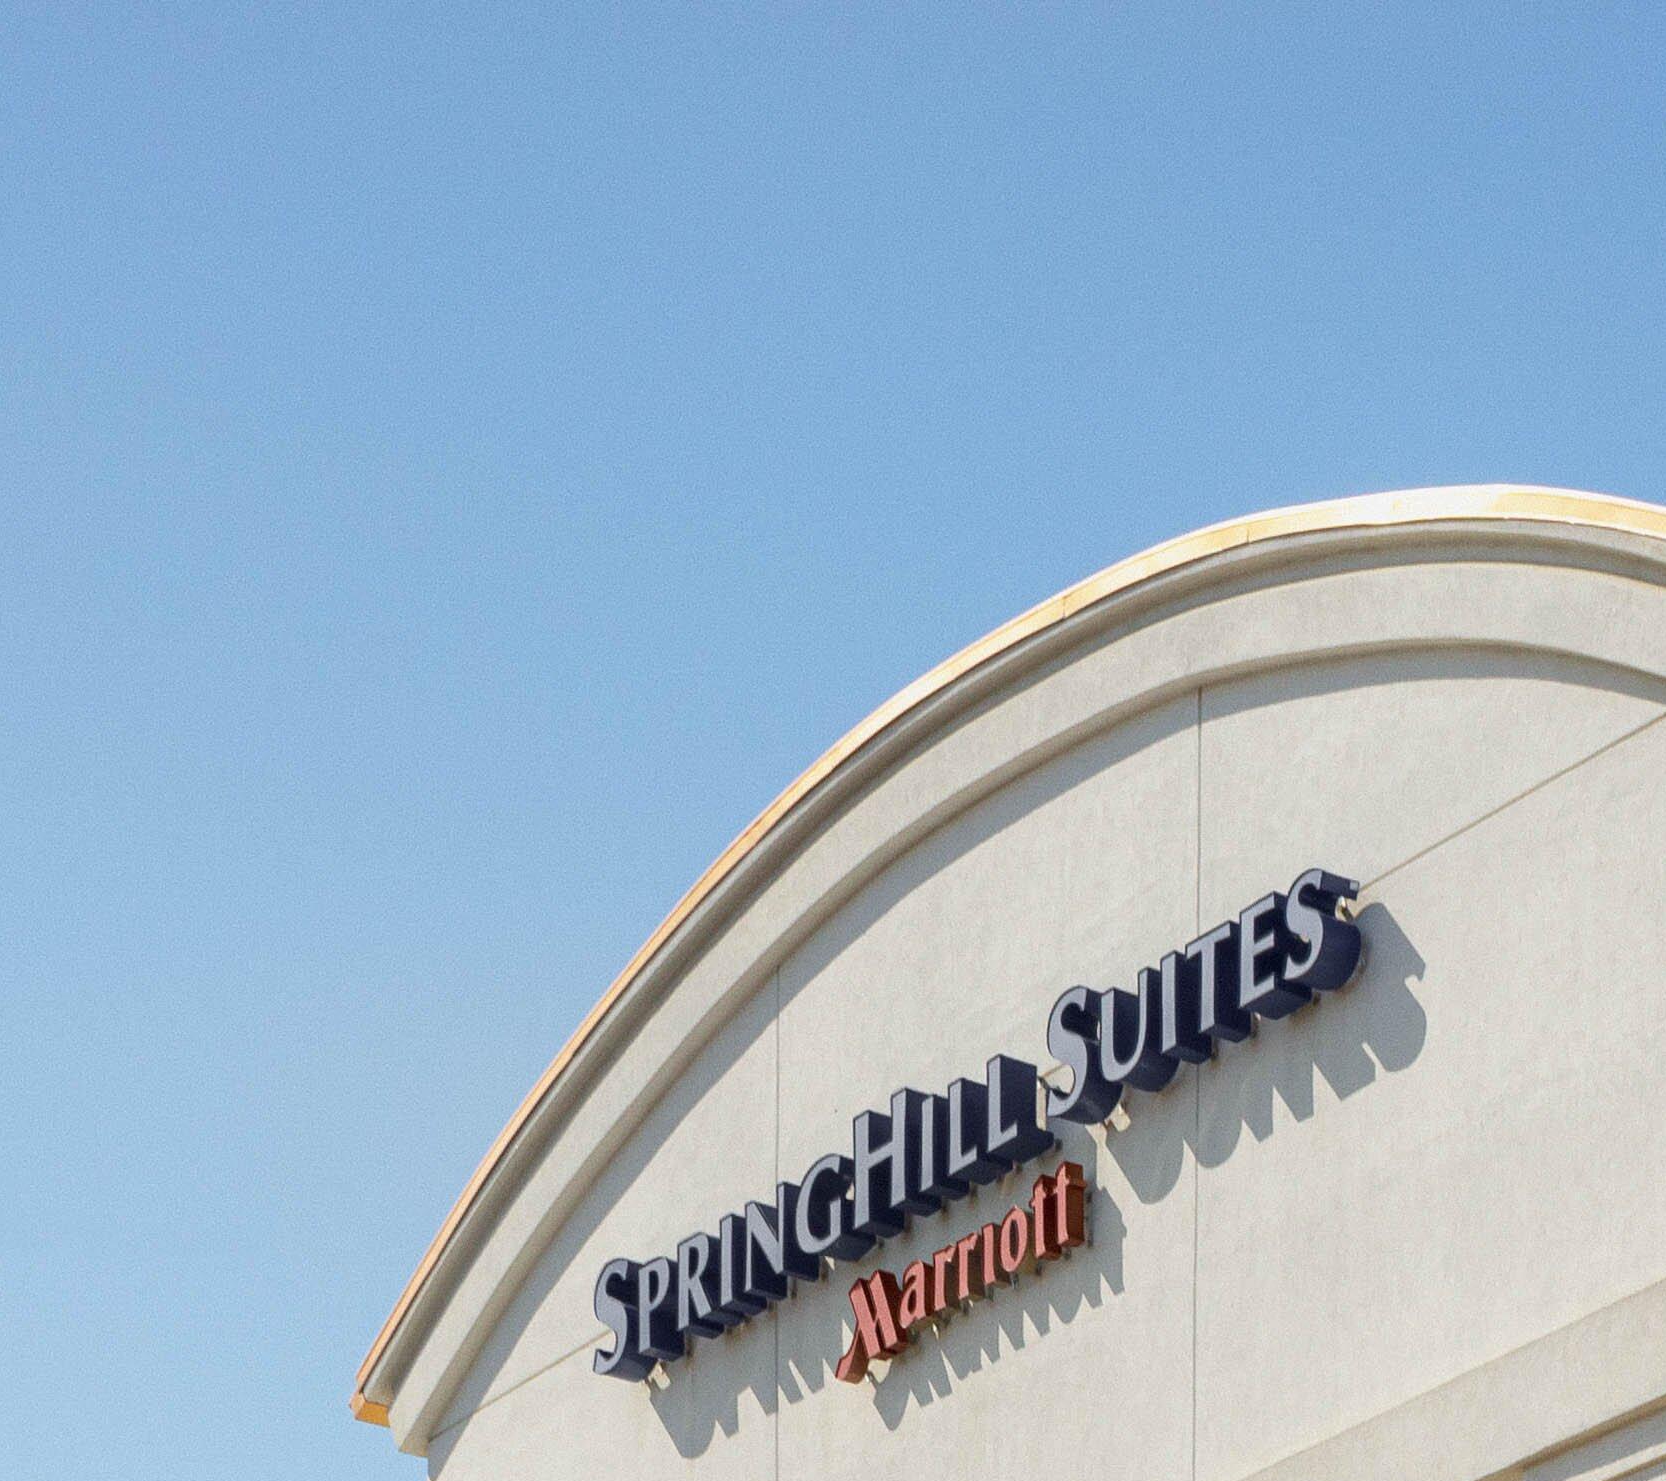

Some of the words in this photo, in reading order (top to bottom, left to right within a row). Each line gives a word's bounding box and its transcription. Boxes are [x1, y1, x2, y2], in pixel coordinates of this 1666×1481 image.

[593, 1053, 1058, 1382] SPRINGHILL
[1047, 868, 1361, 1124] SUITES
[836, 1162, 1090, 1384] Marriott
